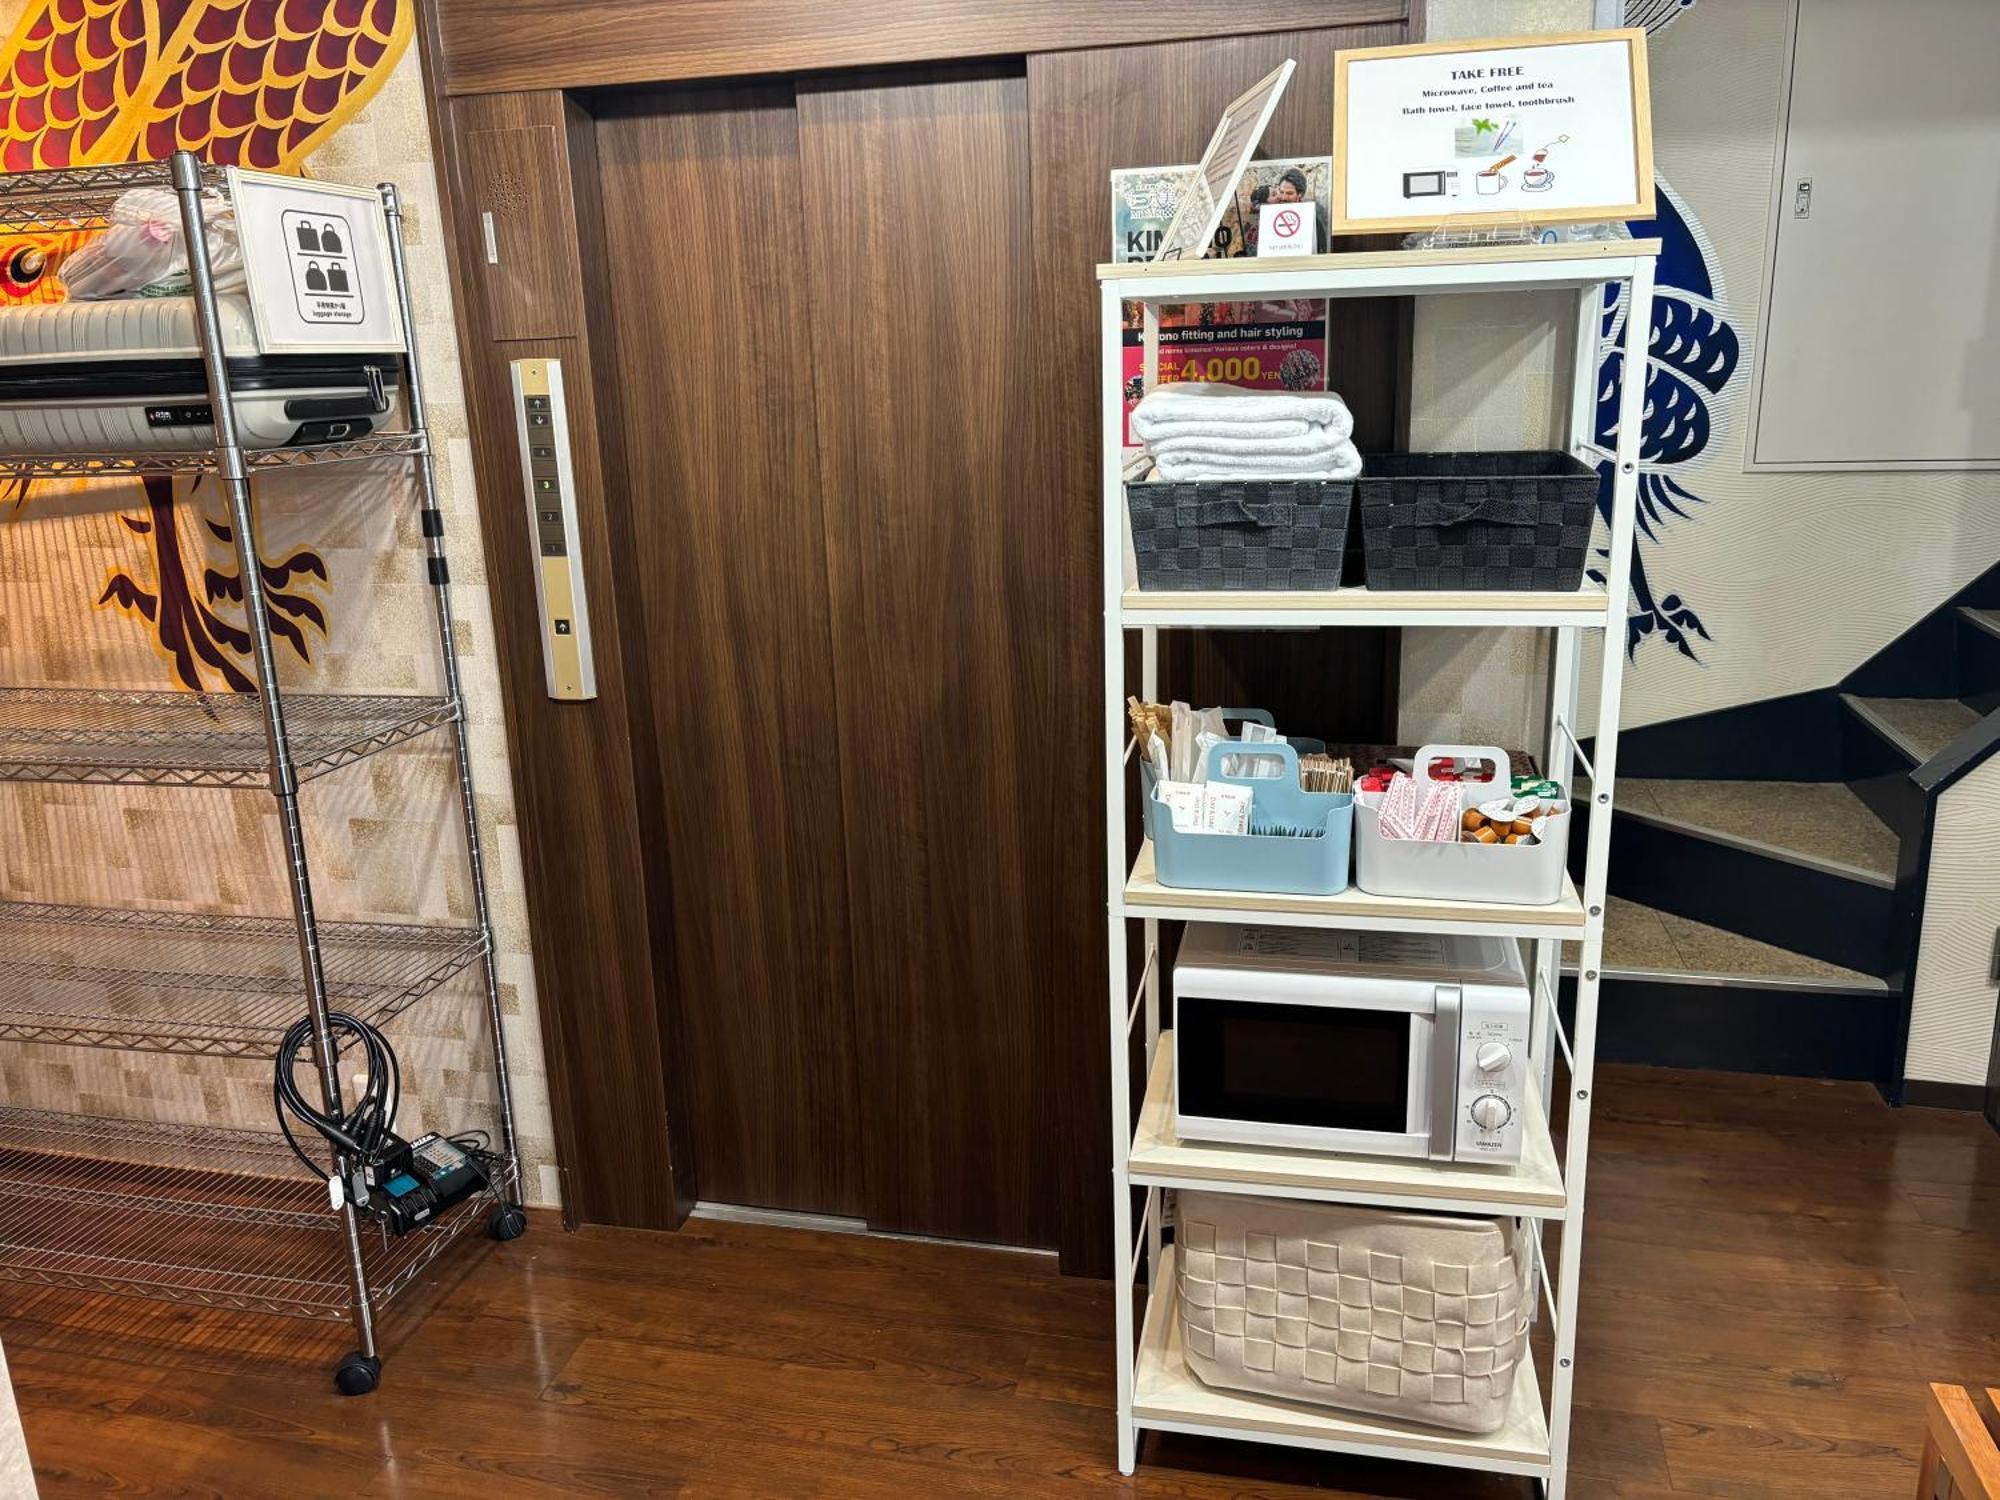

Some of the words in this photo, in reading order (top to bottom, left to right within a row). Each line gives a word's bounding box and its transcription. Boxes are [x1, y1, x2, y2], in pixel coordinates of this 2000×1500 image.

[1450, 68, 1486, 81] TAKE
[1489, 66, 1525, 78] FREE
[1422, 87, 1477, 98] Microwave,
[1480, 84, 1512, 94] Coffee
[1515, 82, 1535, 91] and
[1537, 81, 1554, 90] tea
[1402, 107, 1426, 115] Bath
[1428, 104, 1458, 113] towel,
[1461, 103, 1482, 112] face
[1485, 101, 1515, 110] towel,
[1518, 96, 1575, 107] toothbrush
[1138, 332, 1179, 342] Kono
[1181, 330, 1215, 342] fitting
[1217, 329, 1238, 339] and
[1240, 328, 1262, 338] hair
[1264, 326, 1304, 338] styling
[1139, 362, 1180, 372] SCIAL
[1262, 370, 1280, 380] YEN
